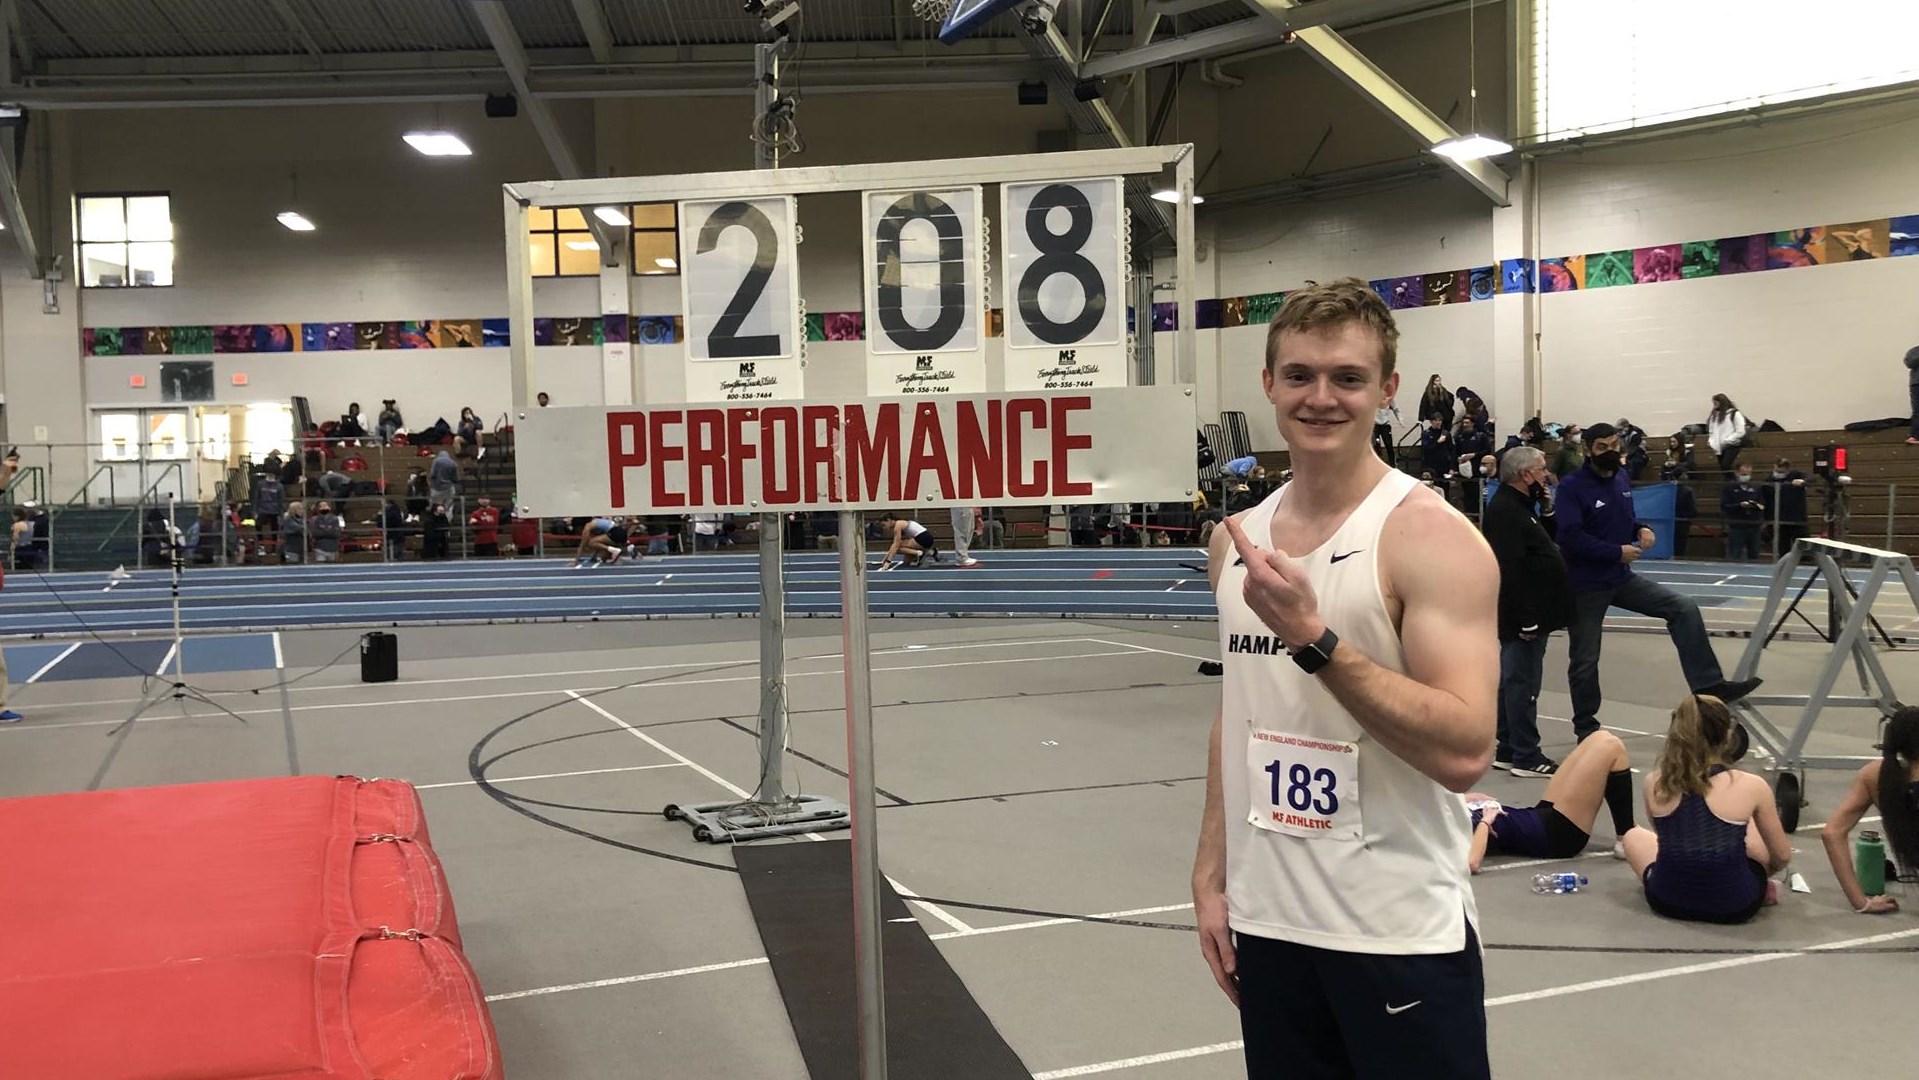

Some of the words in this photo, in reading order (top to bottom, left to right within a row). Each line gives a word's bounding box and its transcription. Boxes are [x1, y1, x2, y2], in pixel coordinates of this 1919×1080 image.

[696, 202, 781, 359] 2
[876, 193, 965, 351] 0
[1017, 183, 1107, 345] 8
[606, 396, 1094, 508] PERFORMANCE
[1229, 634, 1293, 656] HAMP
[1257, 732, 1269, 741] NEW
[1270, 734, 1297, 746] ENGLAND
[1297, 739, 1349, 754] CHAMPIONSHIPS
[1264, 759, 1339, 816] 183
[1285, 814, 1333, 829] ATHLETIC
